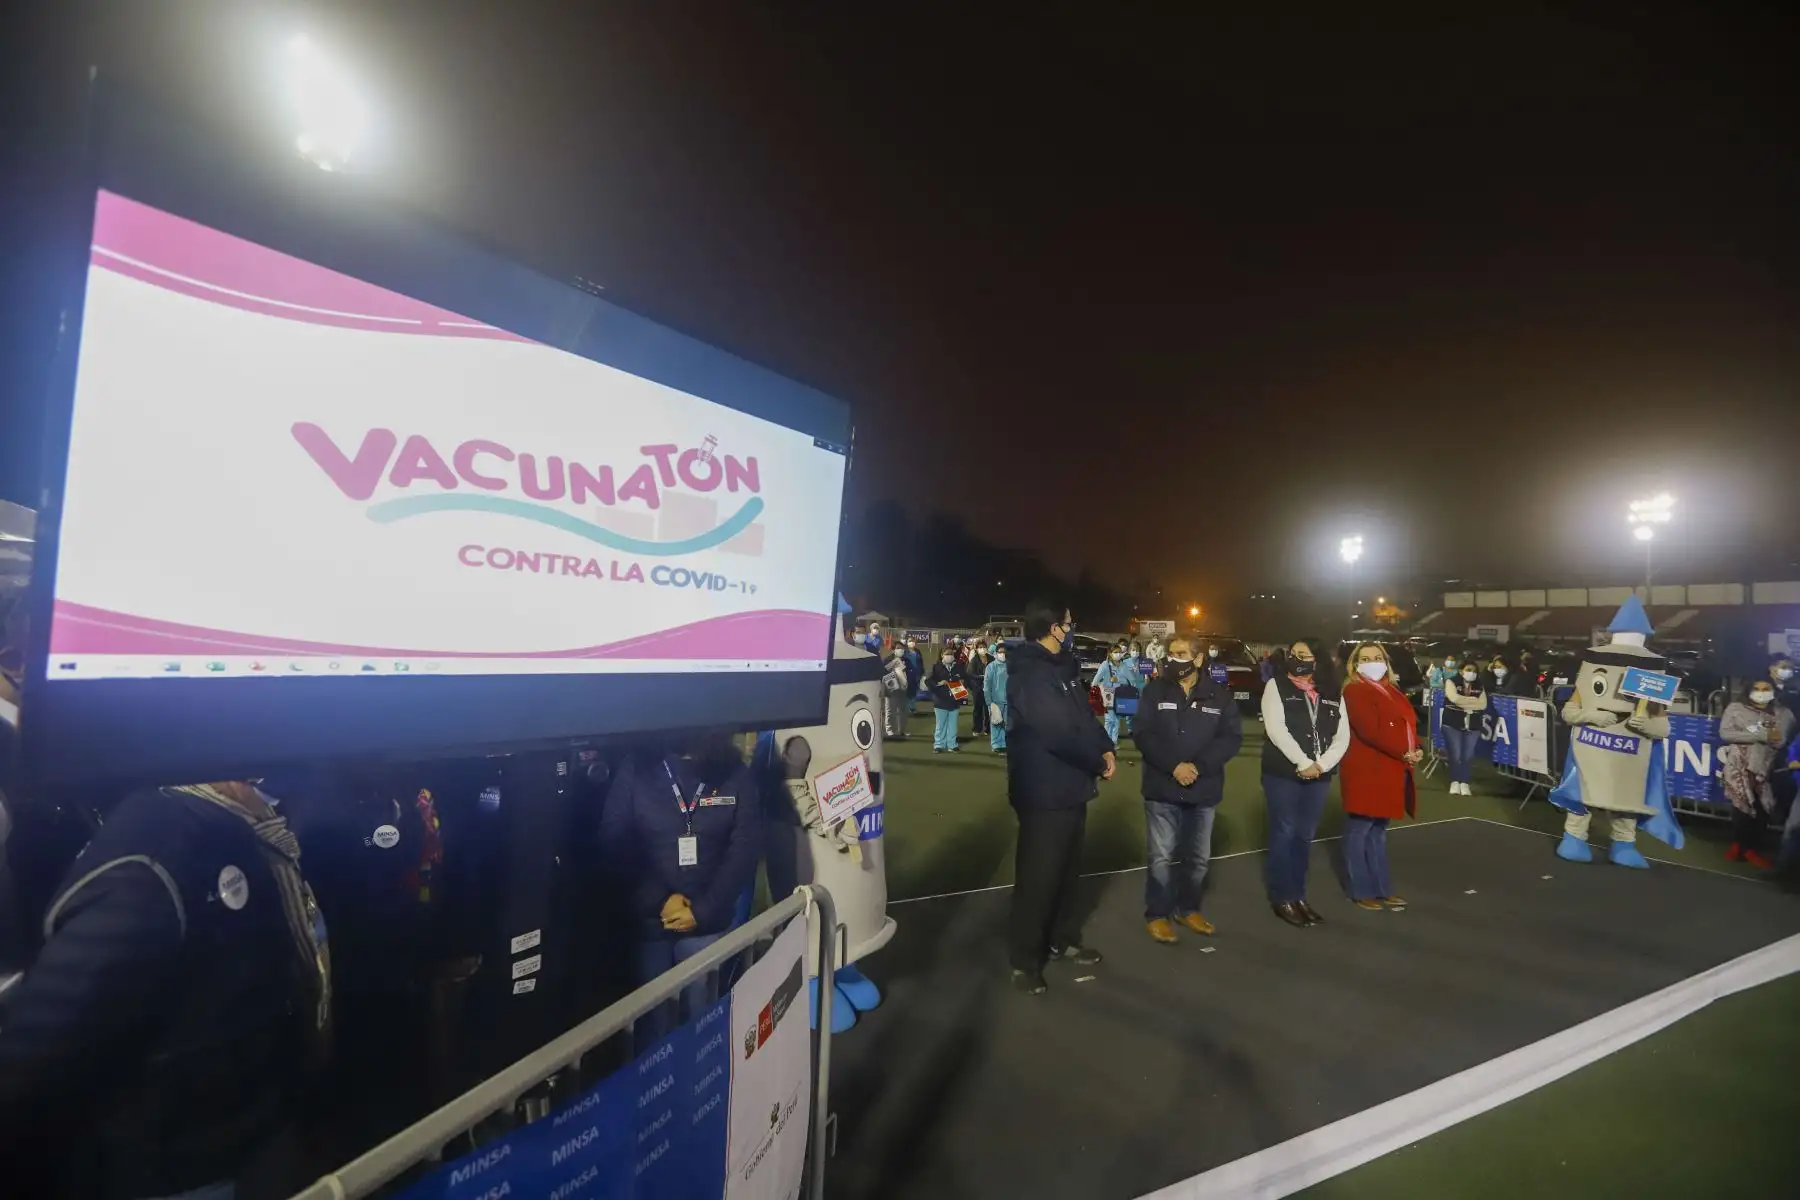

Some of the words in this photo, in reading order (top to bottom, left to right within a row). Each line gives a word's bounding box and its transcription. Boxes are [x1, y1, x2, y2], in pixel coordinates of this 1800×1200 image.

[291, 421, 761, 510] VACUNATÓN
[457, 543, 603, 580] CONTRA
[609, 560, 645, 584] LA
[650, 564, 758, 596] COVID-19
[1580, 730, 1635, 751] MINSA
[695, 1005, 724, 1035] MINSA
[639, 1043, 674, 1076] MINSA
[638, 1074, 675, 1109] MINSA
[552, 1092, 601, 1128] MINSA
[552, 1126, 600, 1167] MINSA
[450, 1143, 512, 1188] MINSA
